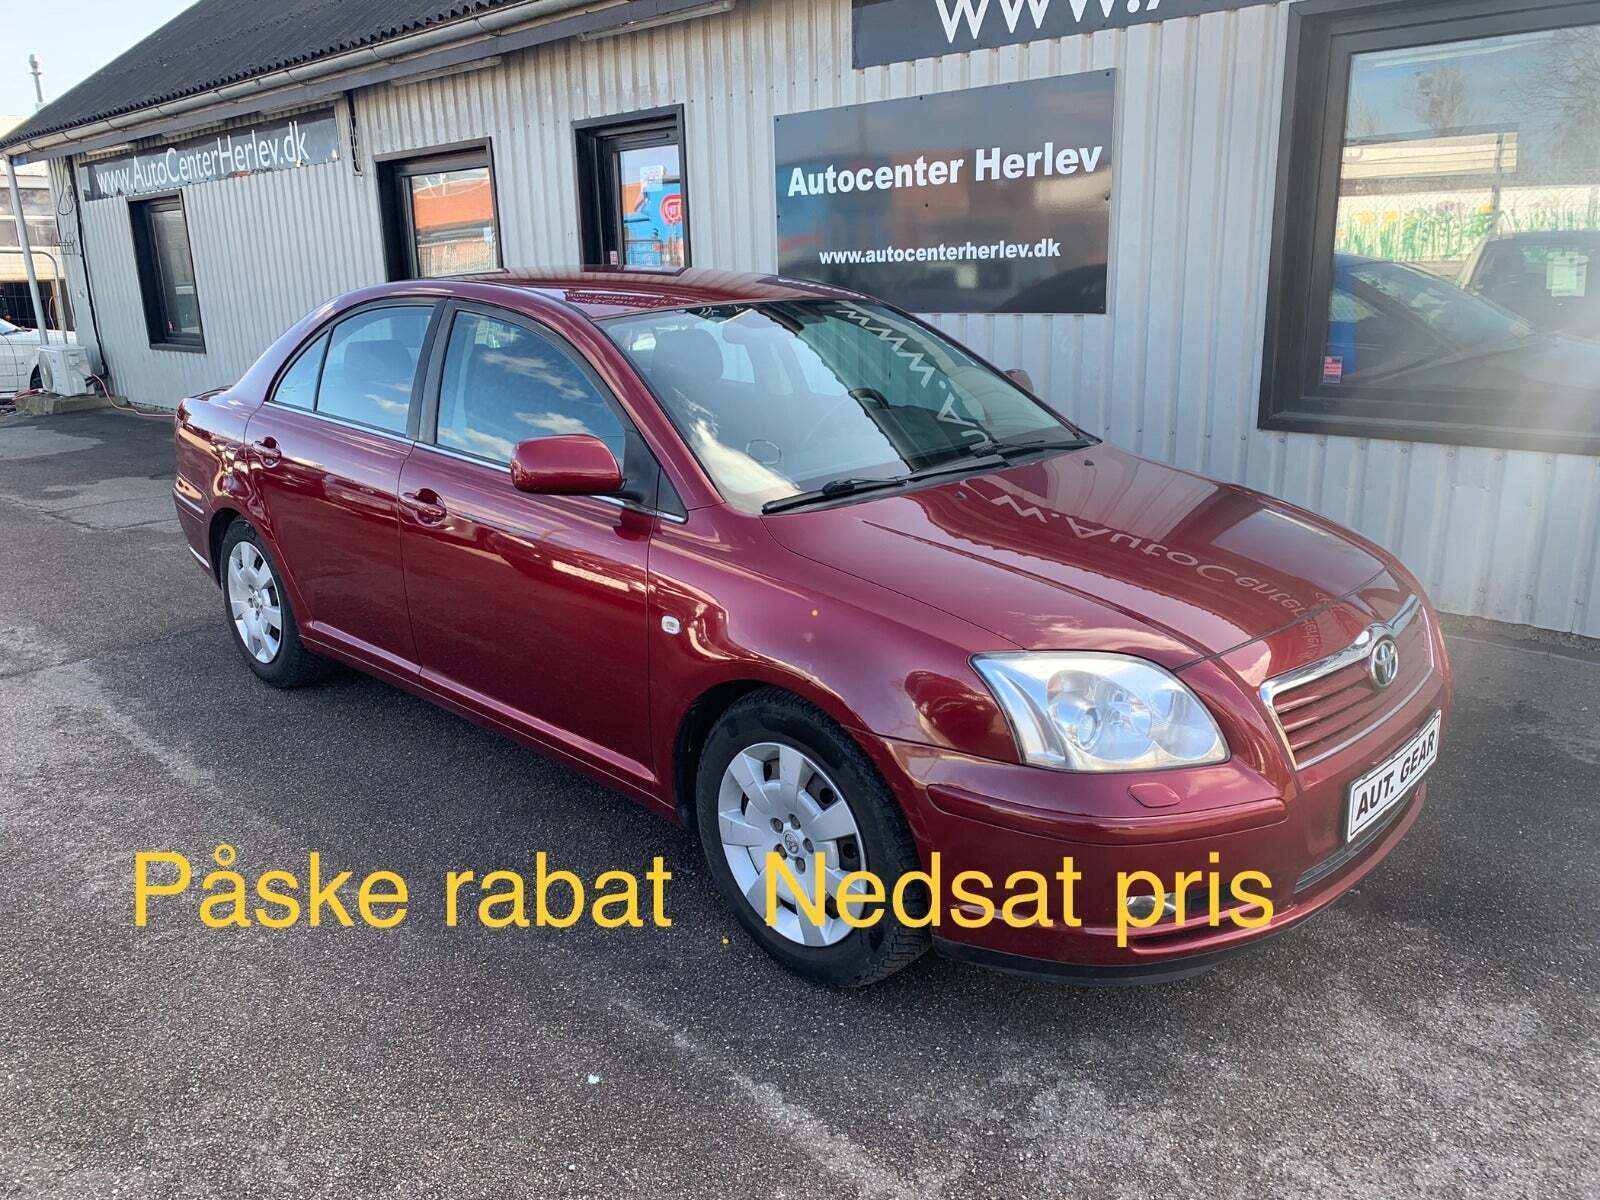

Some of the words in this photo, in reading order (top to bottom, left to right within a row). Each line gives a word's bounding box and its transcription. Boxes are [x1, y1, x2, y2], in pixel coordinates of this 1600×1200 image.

[96, 120, 309, 193] www.AutoCenterHerlev.dk
[787, 153, 964, 197] Autocenter
[975, 142, 1102, 181] Herlev
[819, 238, 1061, 264] www.autocenterherlev.dk
[1356, 771, 1395, 821] AUT.
[1401, 730, 1435, 783] GEAR
